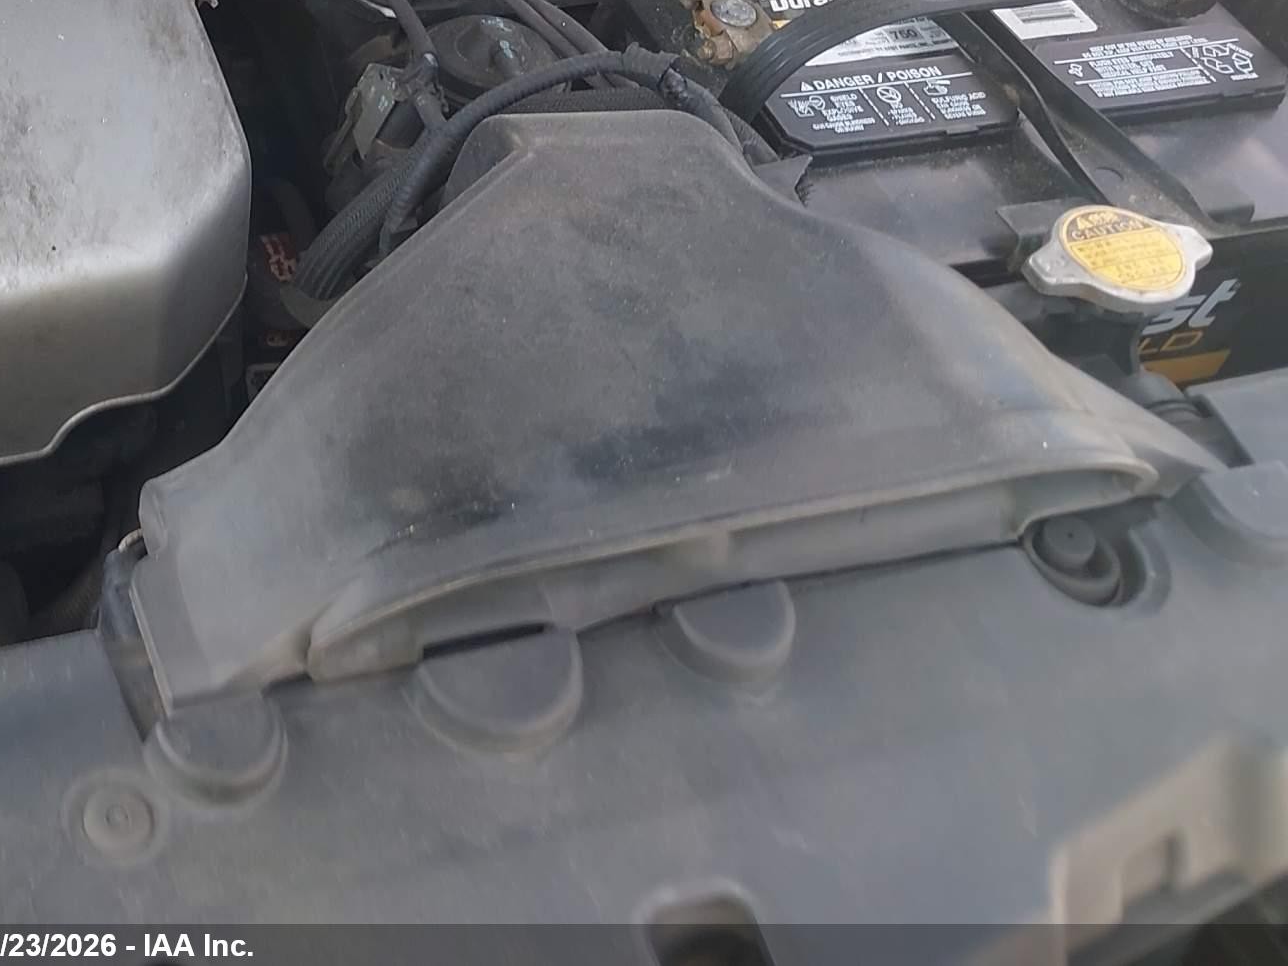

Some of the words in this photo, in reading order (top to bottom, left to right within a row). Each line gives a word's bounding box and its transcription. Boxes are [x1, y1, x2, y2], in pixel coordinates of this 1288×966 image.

[813, 73, 875, 91] DANGER
[888, 65, 943, 82] POISON
[1071, 219, 1145, 241] CAUTION
